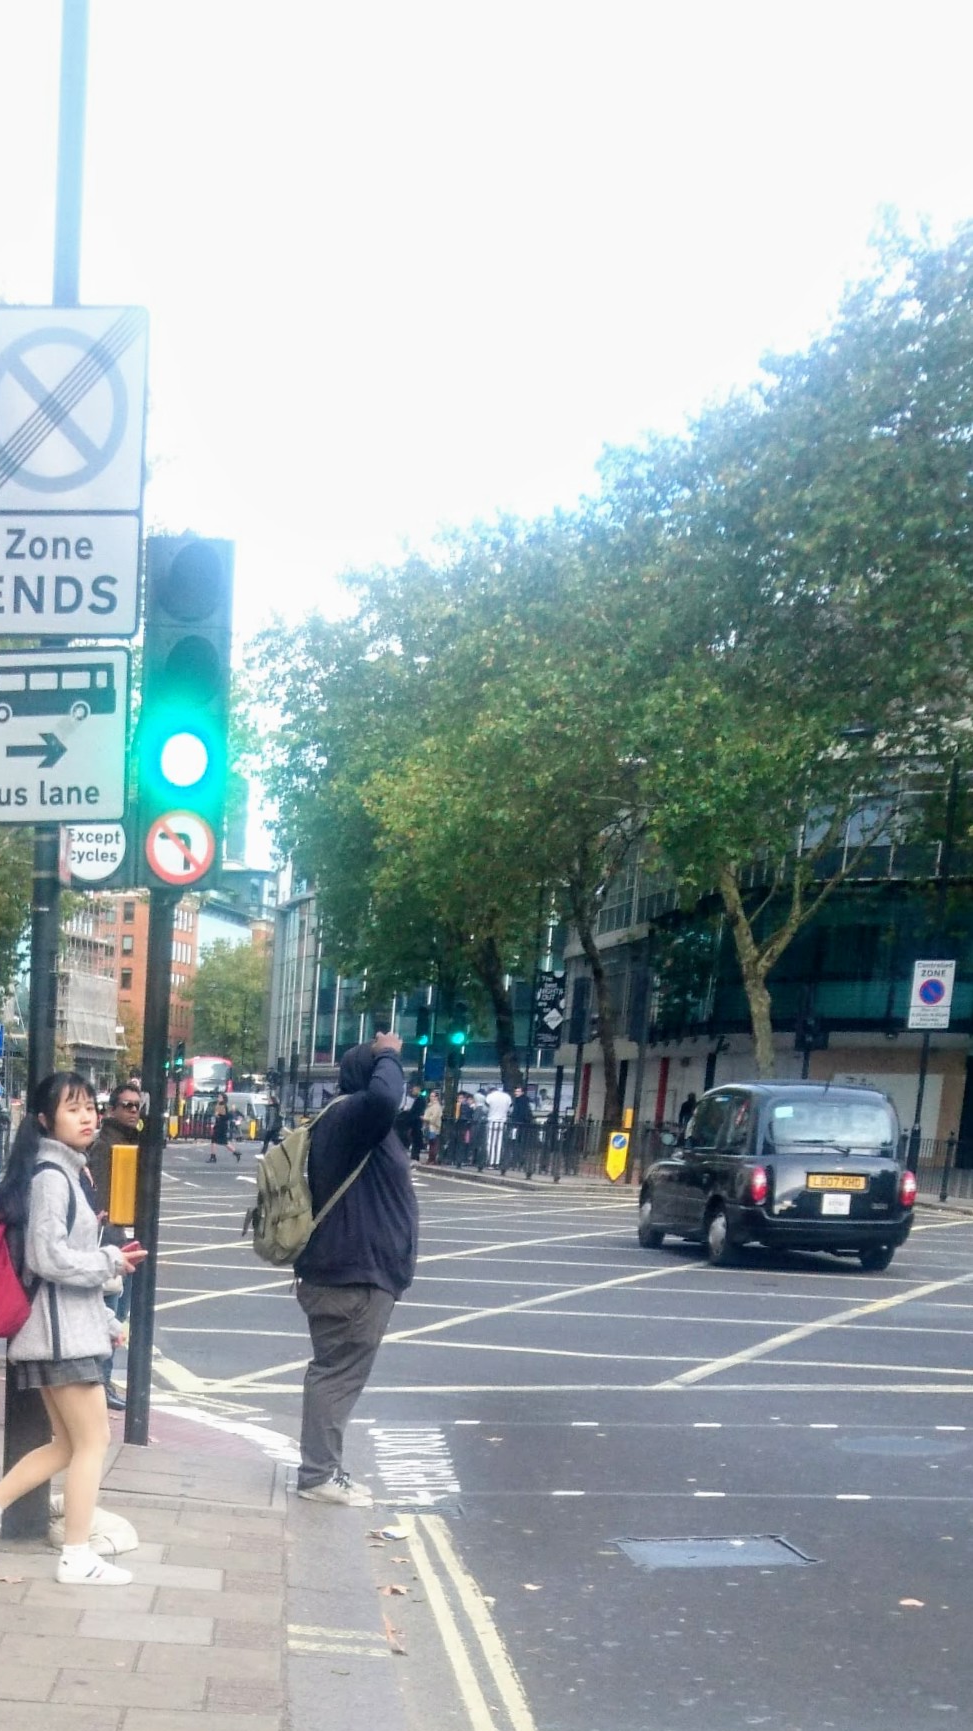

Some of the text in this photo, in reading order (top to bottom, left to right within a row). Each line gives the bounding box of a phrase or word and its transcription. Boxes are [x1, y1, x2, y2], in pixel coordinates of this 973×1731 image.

[5, 528, 94, 561] Zone
[39, 780, 100, 805] lane
[67, 828, 121, 846] Except
[70, 847, 118, 864] cycles
[921, 969, 947, 977] ZONE
[368, 1428, 451, 1457] LOOK
[375, 1459, 462, 1493] RIGHT
